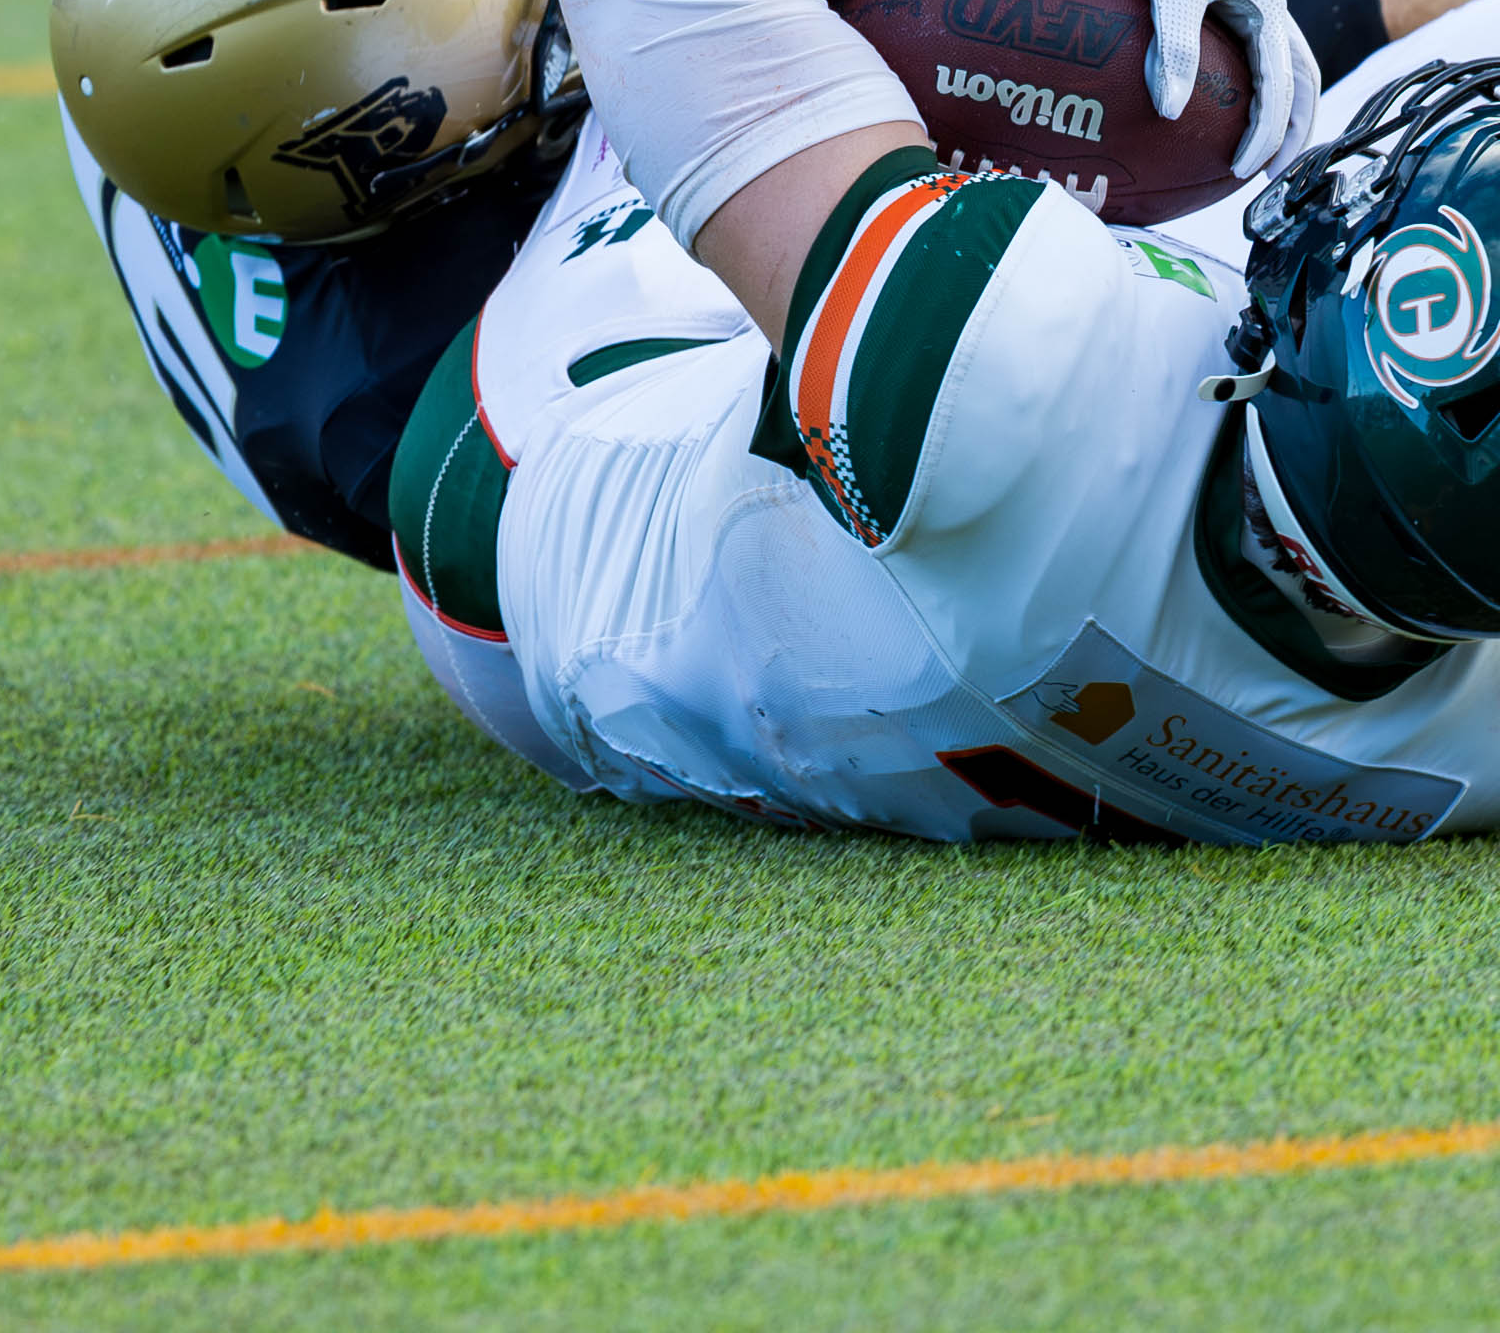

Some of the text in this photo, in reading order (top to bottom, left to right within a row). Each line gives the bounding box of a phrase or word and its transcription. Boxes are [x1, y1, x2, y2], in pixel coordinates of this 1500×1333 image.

[936, 63, 1105, 142] Wilson
[1117, 746, 1190, 791] Haus
[1190, 786, 1248, 814] der
[1146, 714, 1435, 834] Sanitätshaus
